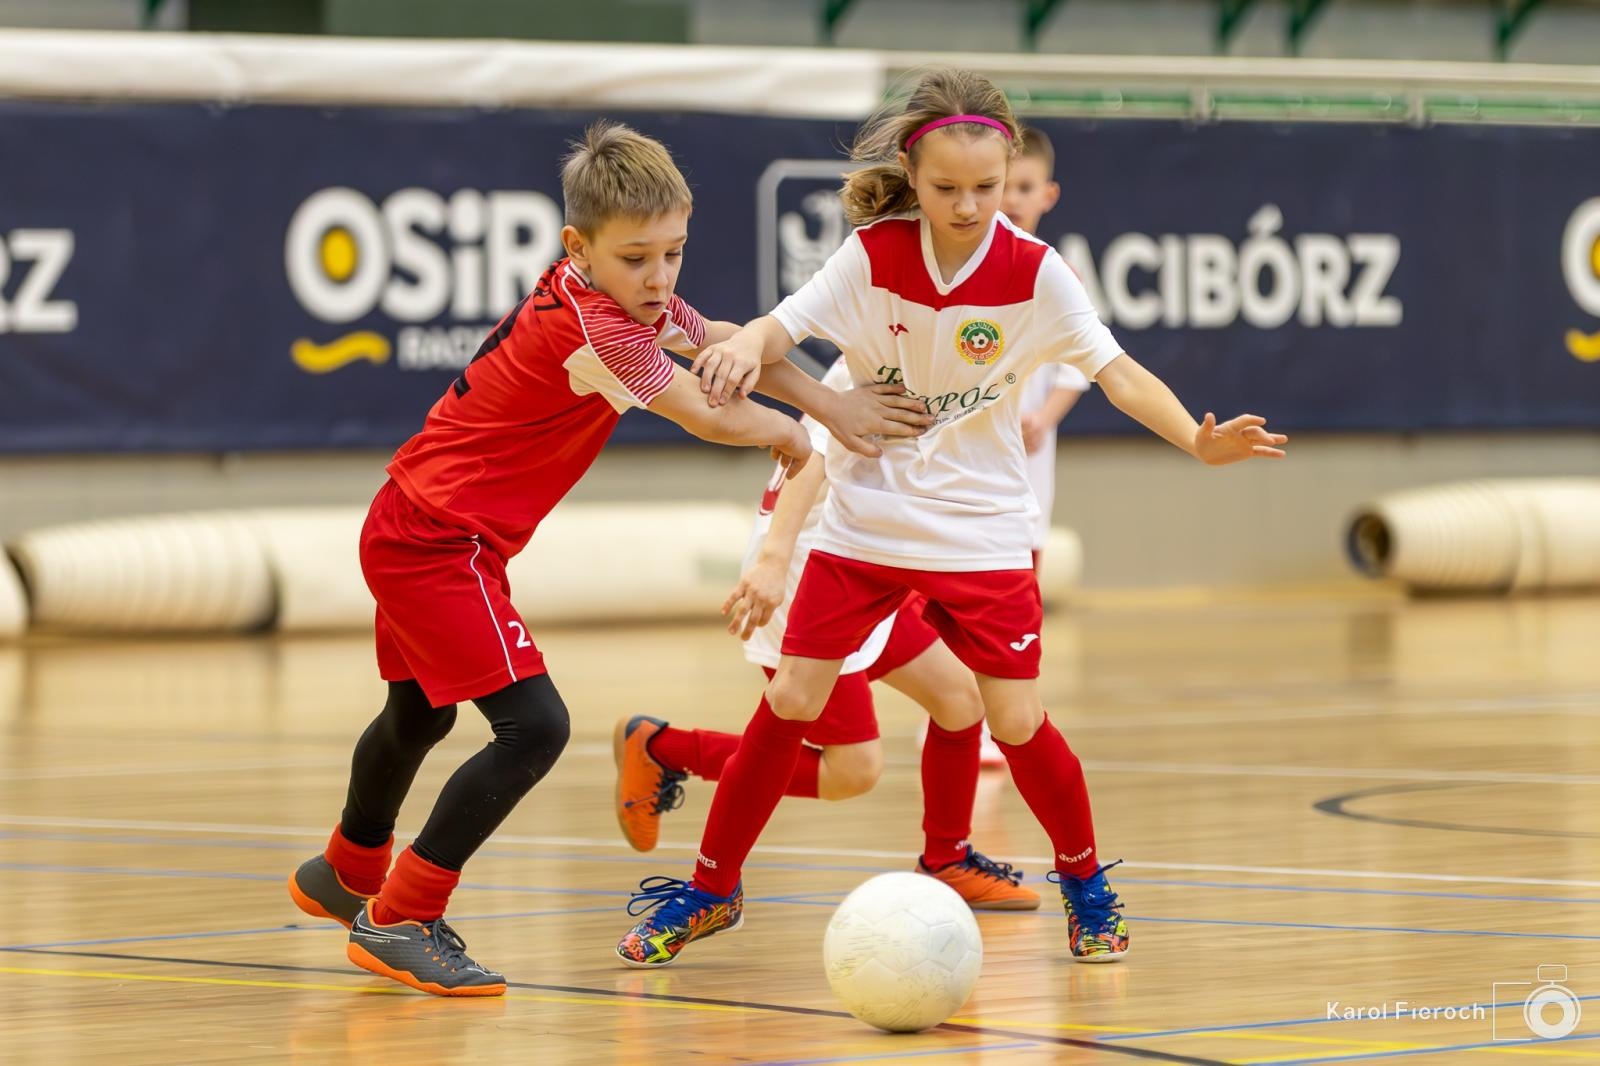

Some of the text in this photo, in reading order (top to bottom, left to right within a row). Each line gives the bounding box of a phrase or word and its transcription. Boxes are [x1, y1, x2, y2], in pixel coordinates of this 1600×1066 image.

[285, 186, 563, 323] OSiR
[1059, 203, 1402, 330] ACIBÓRZ
[508, 620, 531, 648] 2
